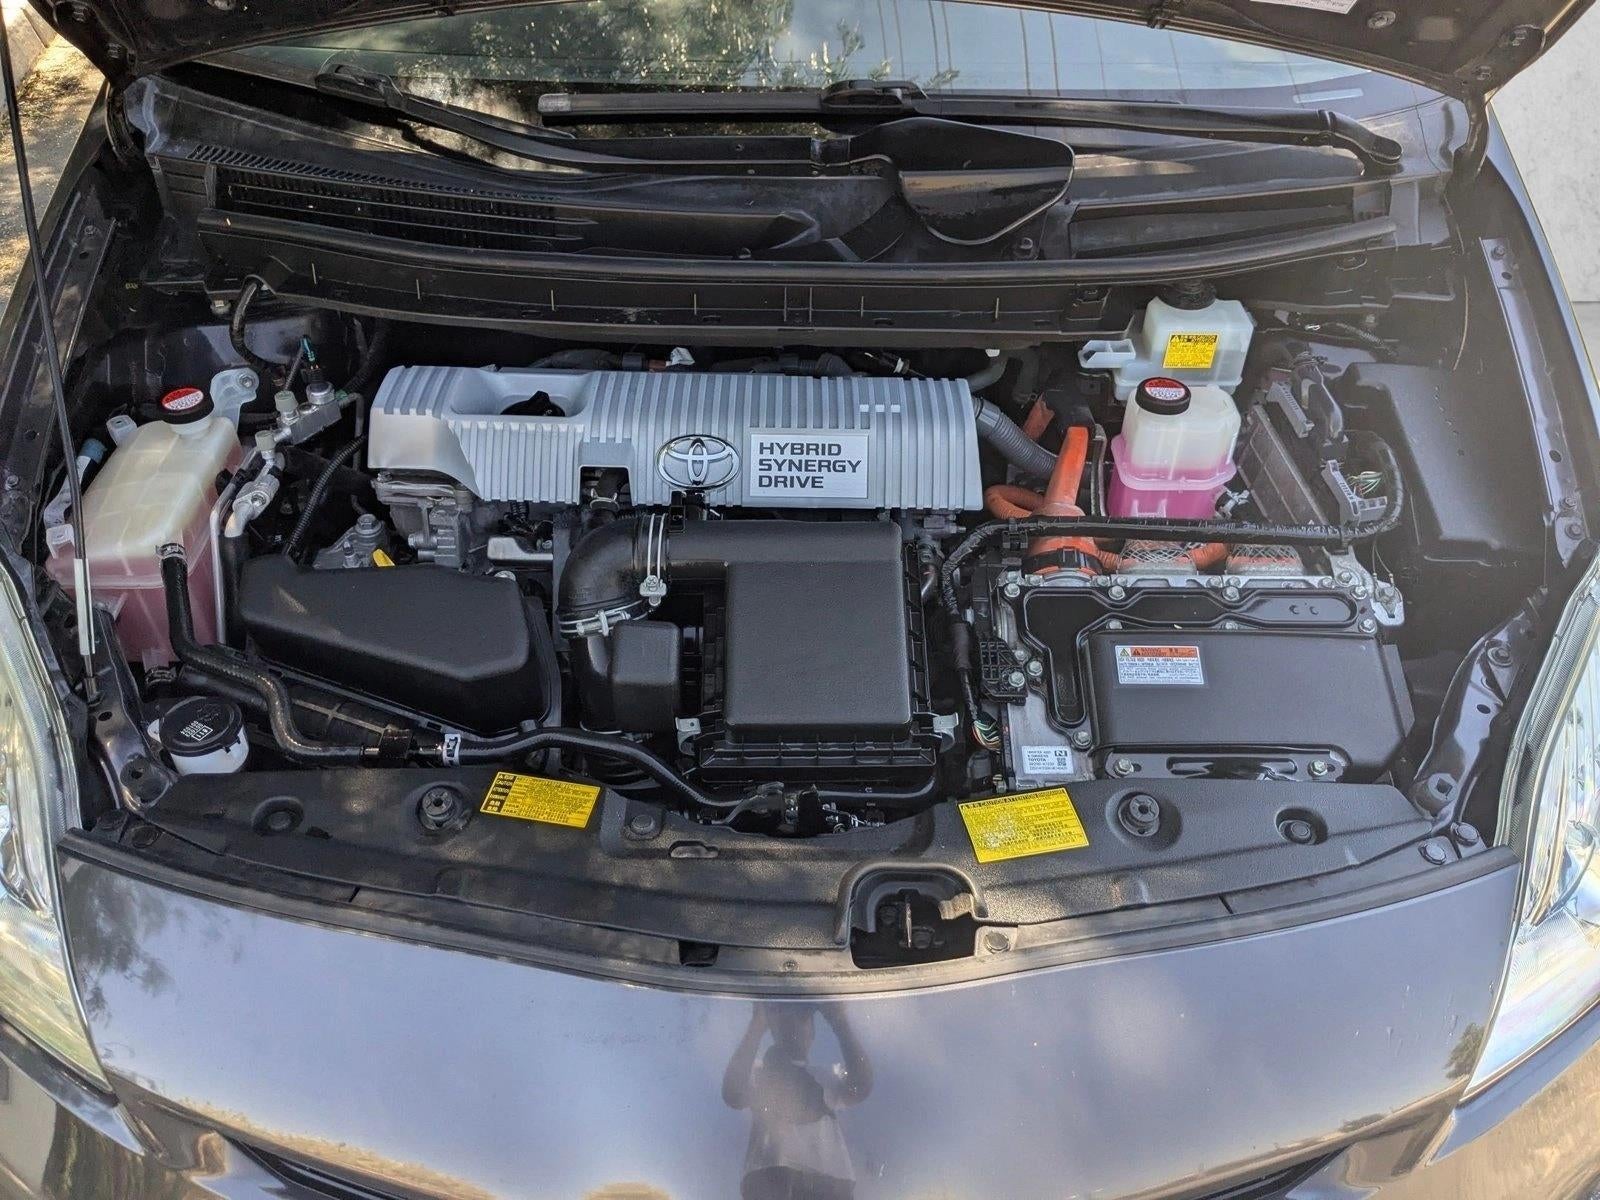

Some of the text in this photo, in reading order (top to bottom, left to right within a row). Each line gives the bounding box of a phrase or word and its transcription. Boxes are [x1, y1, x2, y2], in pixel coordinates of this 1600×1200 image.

[759, 442, 842, 456] HYBRID
[758, 458, 862, 473] SYNERGY
[758, 475, 824, 489] DRIVE
